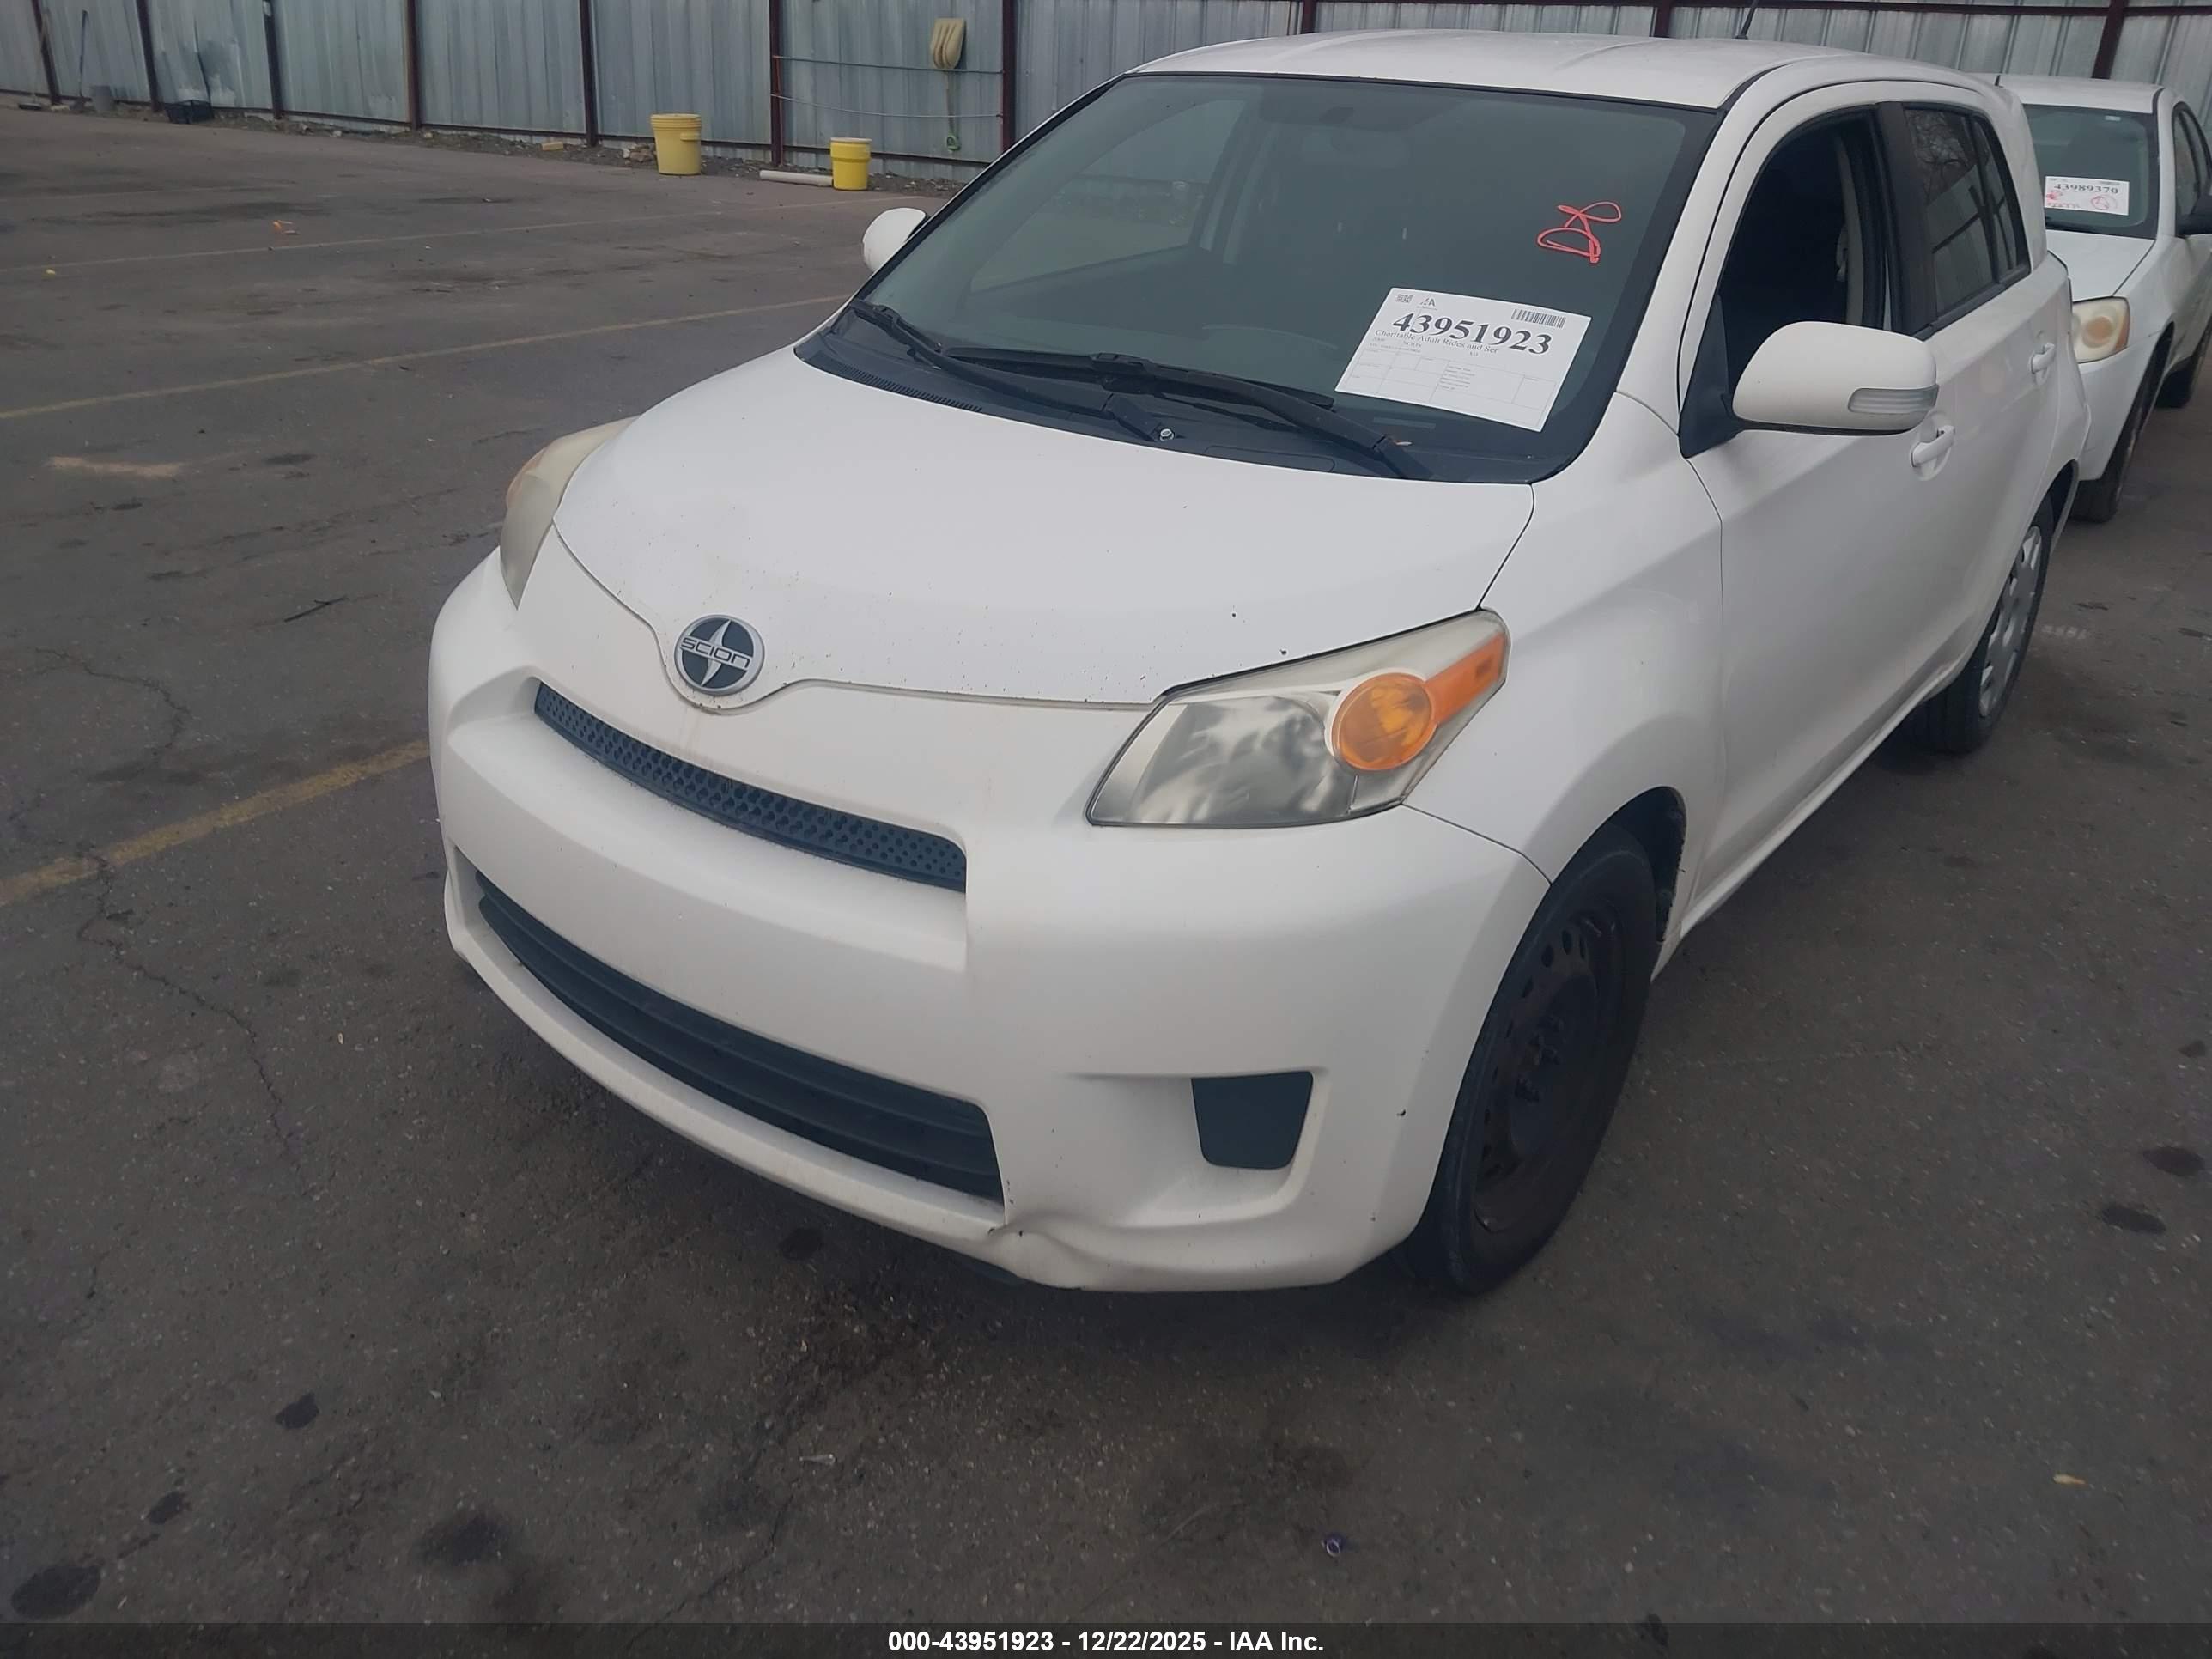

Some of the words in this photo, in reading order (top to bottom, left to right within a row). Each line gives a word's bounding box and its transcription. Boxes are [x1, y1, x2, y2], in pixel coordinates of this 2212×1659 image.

[2054, 183, 2119, 194] 43989370
[1375, 329, 1416, 341] Charitable
[1418, 336, 1441, 344] Adult
[1442, 337, 1465, 348] Rides
[1484, 345, 1498, 354] Ser
[1392, 312, 1553, 355] 43951923
